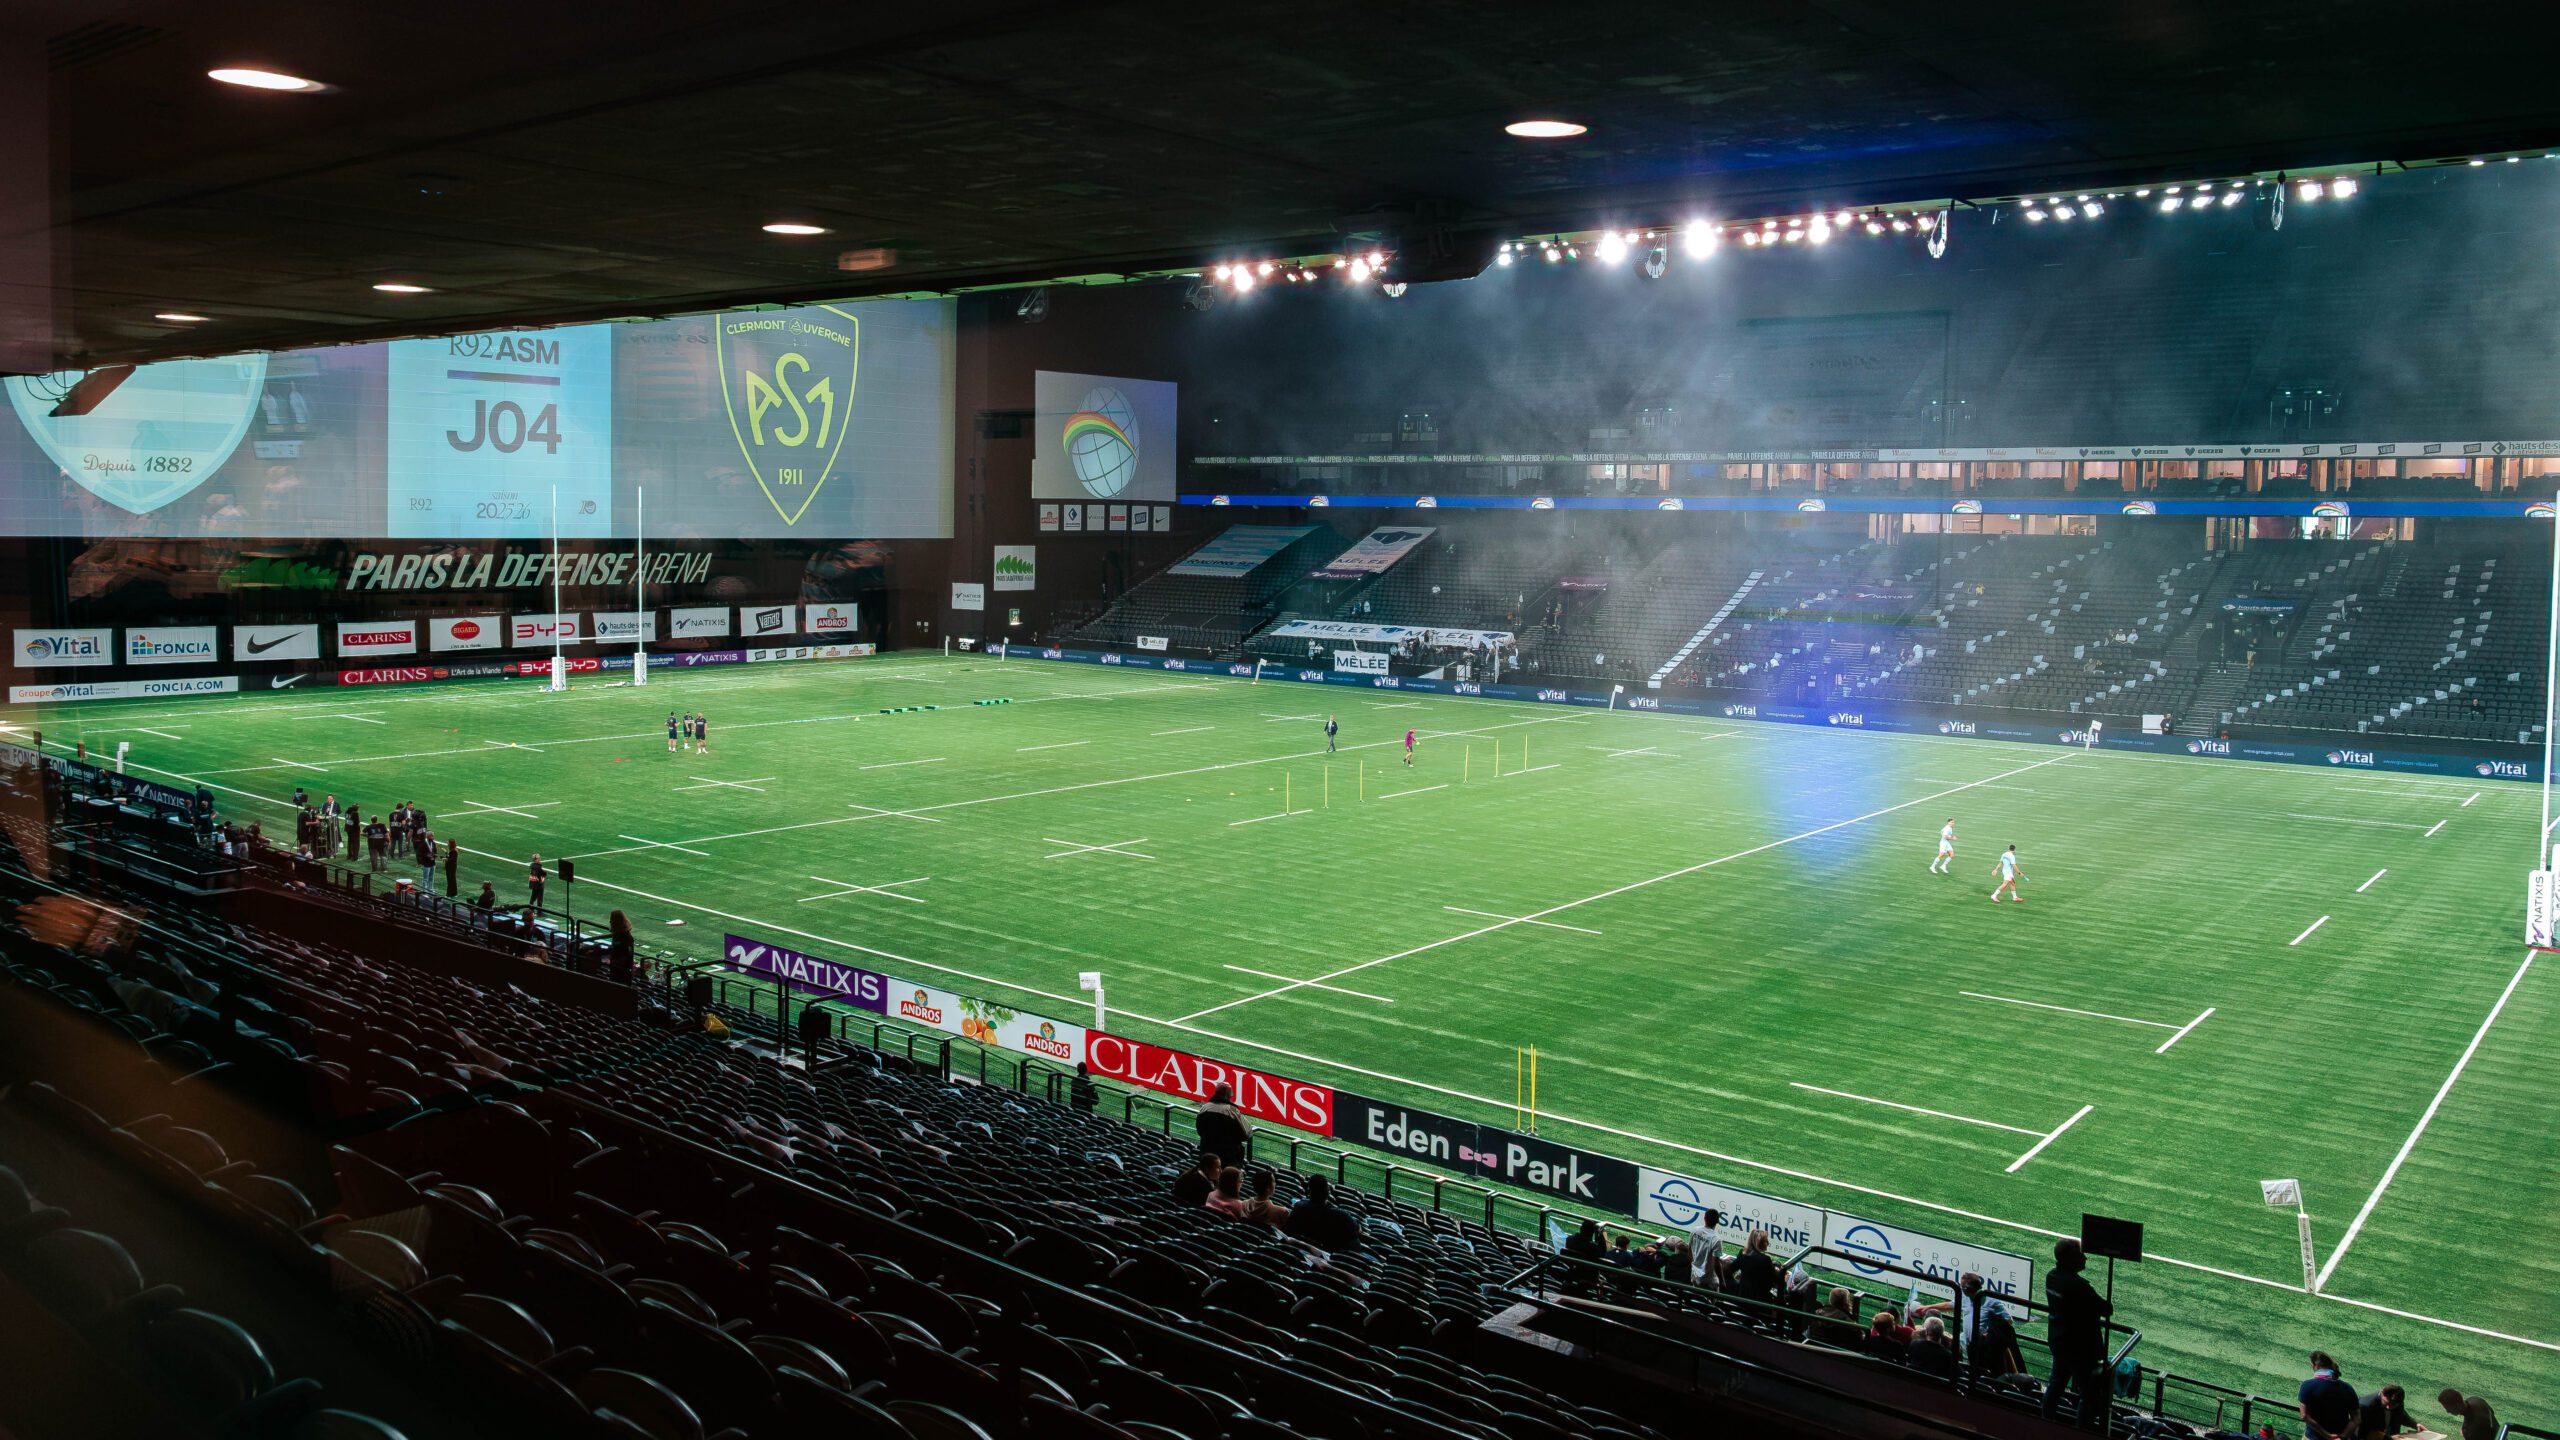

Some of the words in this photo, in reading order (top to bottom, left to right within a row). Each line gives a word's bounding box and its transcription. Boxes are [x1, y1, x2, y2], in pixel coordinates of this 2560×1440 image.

[726, 320, 787, 335] CLERMONT
[2509, 441, 2560, 450] hauts-de-s
[1727, 452, 1742, 460] PARIS
[1750, 452, 1774, 460] DEFENSE
[1811, 451, 1828, 460] PARIS
[1828, 451, 1836, 459] LA
[1836, 451, 1860, 459] DEFENSE
[83, 454, 136, 476] Depuis
[143, 456, 193, 473] 1882
[778, 468, 803, 485] 1911
[409, 498, 433, 511] R92
[346, 554, 453, 590] PARIS
[451, 554, 494, 588] LA
[495, 553, 634, 587] DEFENSE
[629, 552, 713, 585] ARENA
[609, 622, 652, 630] hauts-de-sine
[691, 618, 726, 627] NATIXIS
[817, 618, 847, 628] ANDROS
[1310, 624, 1374, 634] MÊLÉE
[516, 622, 576, 638] BYD
[347, 632, 407, 644] CLARINS
[48, 636, 101, 655] Vital
[154, 642, 211, 654] FONCIA
[701, 654, 738, 663] NATIXIS
[1336, 655, 1387, 670] MÊLÉE
[344, 667, 427, 684] CLARINS
[1236, 665, 1252, 674] Vital
[1306, 670, 1323, 680] Vital
[144, 681, 224, 693] FONCIA.COM
[1380, 676, 1398, 686] Vital
[1461, 683, 1480, 692] Vital
[18, 689, 51, 698] Groupe
[64, 686, 94, 697] Vital
[1546, 689, 1566, 700] Vital
[1636, 696, 1659, 708] Vital
[1732, 704, 1756, 716] Vital
[1838, 712, 1863, 725] Vital
[1949, 721, 1976, 734] Vital
[2199, 739, 2230, 754] Vital
[2340, 750, 2374, 764] Vital
[2490, 760, 2528, 776] Vital
[2534, 876, 2544, 923] NATIXIS
[772, 950, 880, 1001] NATIXIS
[902, 1003, 941, 1024] ANDROS
[1026, 1037, 1071, 1059] ANDROS
[1089, 1036, 1327, 1127] CLARINS
[1368, 1107, 1449, 1159] Eden
[1506, 1143, 1594, 1198] Park
[1718, 1200, 1811, 1231] GROUPE
[1717, 1211, 1811, 1247] SATURNE
[1913, 1247, 2017, 1282] GROUPE
